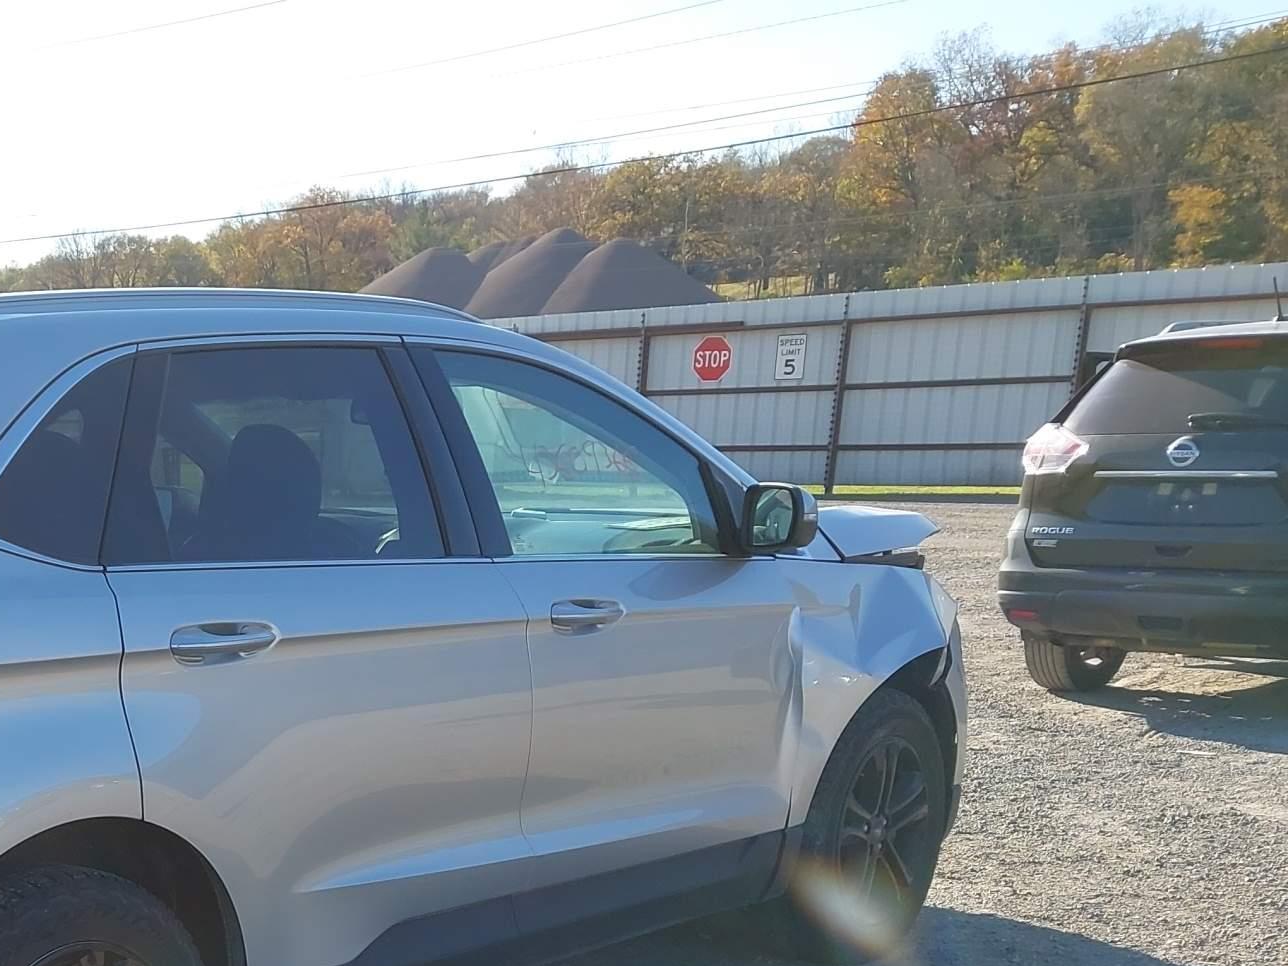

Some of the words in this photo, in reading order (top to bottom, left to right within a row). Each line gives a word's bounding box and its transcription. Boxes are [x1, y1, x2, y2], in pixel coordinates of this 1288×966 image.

[780, 338, 805, 346] SPEED
[781, 348, 801, 356] LIMIT
[695, 350, 729, 368] STOP
[783, 358, 796, 375] 5
[1031, 526, 1075, 535] ROGUE
